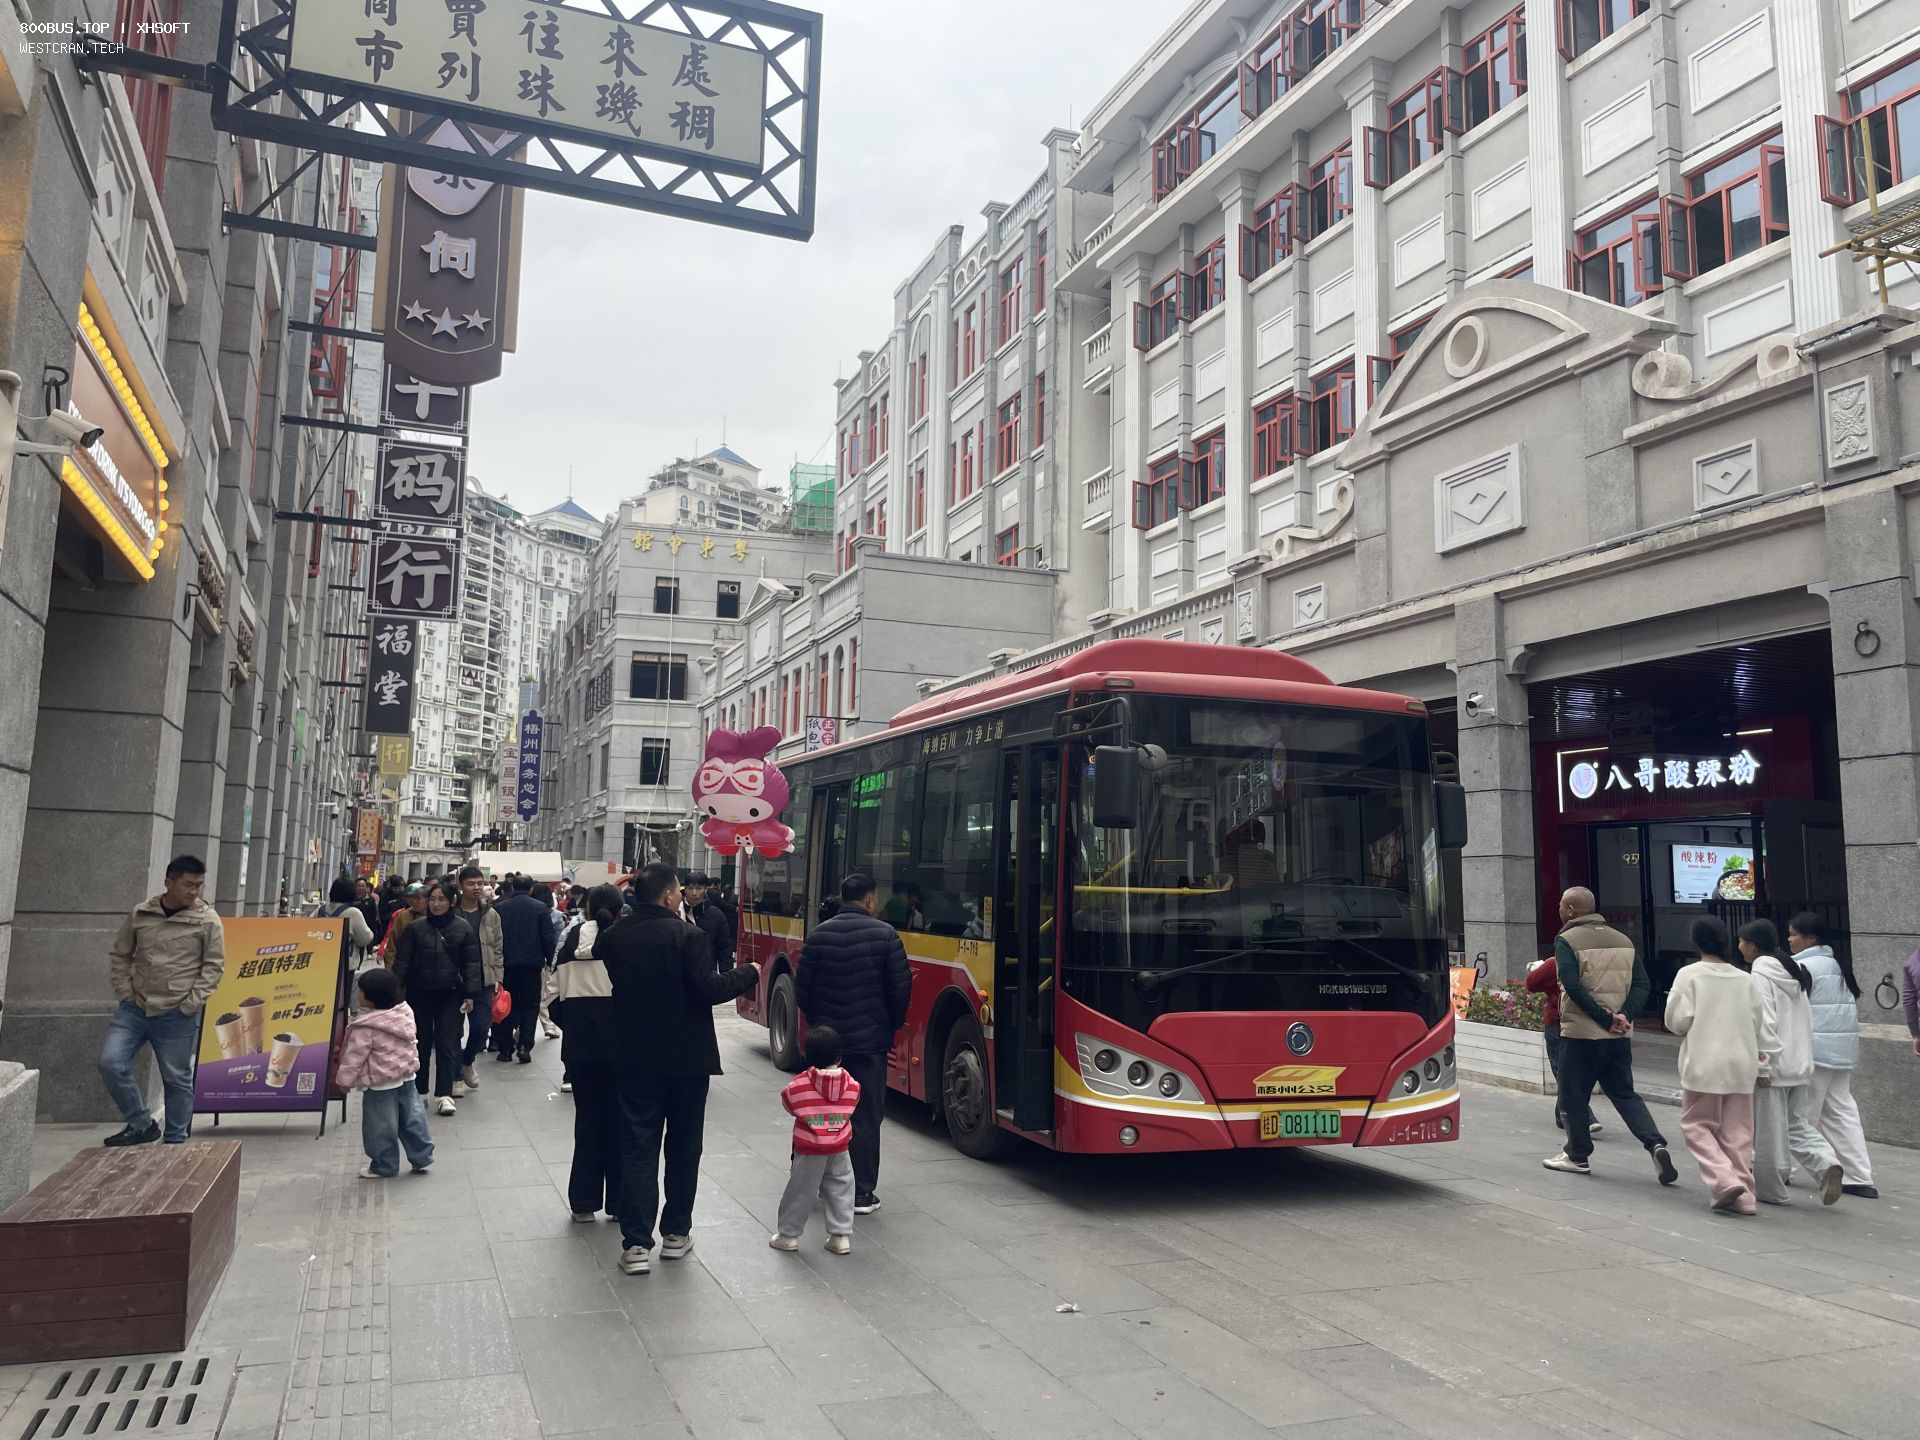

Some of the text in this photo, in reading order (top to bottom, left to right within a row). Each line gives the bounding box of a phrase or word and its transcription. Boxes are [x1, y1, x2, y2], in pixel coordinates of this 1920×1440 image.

[355, 30, 718, 151] 市列珠璣稠
[373, 625, 412, 707] 福堂
[822, 719, 835, 745] 正宗
[922, 719, 1004, 755] 海纳百川 力争上游
[1603, 748, 1762, 793] 八哥酸辣粉
[1680, 850, 1718, 865] 酸辣粉
[237, 951, 314, 980] 超值特惠
[1257, 1084, 1335, 1095] 梧州公交
